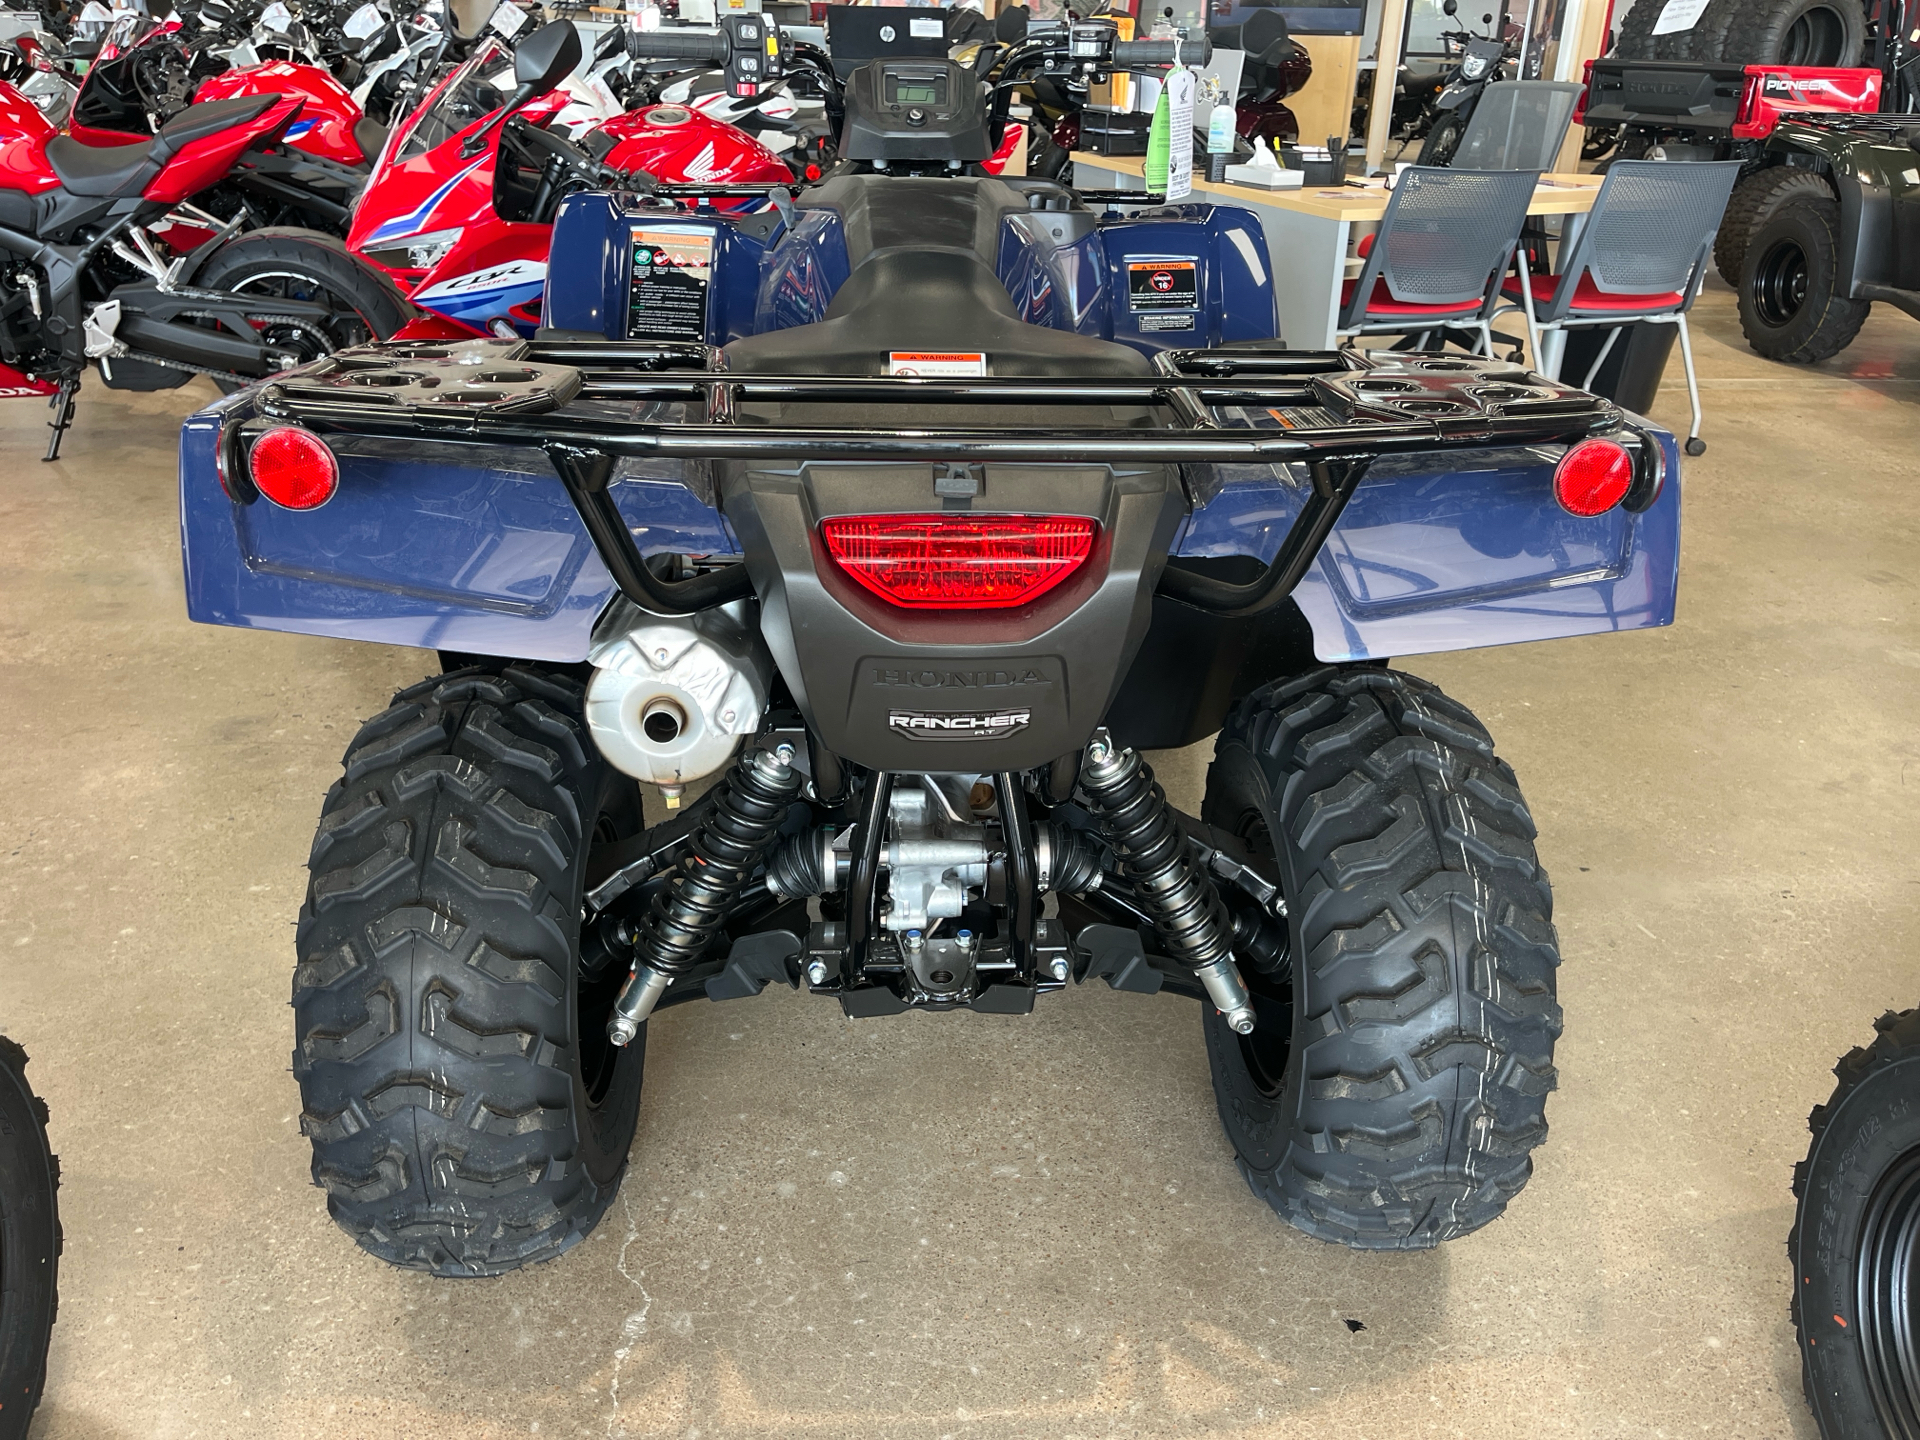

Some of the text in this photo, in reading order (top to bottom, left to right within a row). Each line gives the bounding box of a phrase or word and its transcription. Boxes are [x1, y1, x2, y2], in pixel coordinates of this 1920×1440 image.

[882, 26, 893, 42] hp
[1630, 82, 1692, 95] HONDA
[1766, 80, 1828, 90] PIONEER
[446, 266, 527, 290] CBR
[872, 668, 1052, 688] HONDA
[890, 714, 1030, 728] RANCHER
